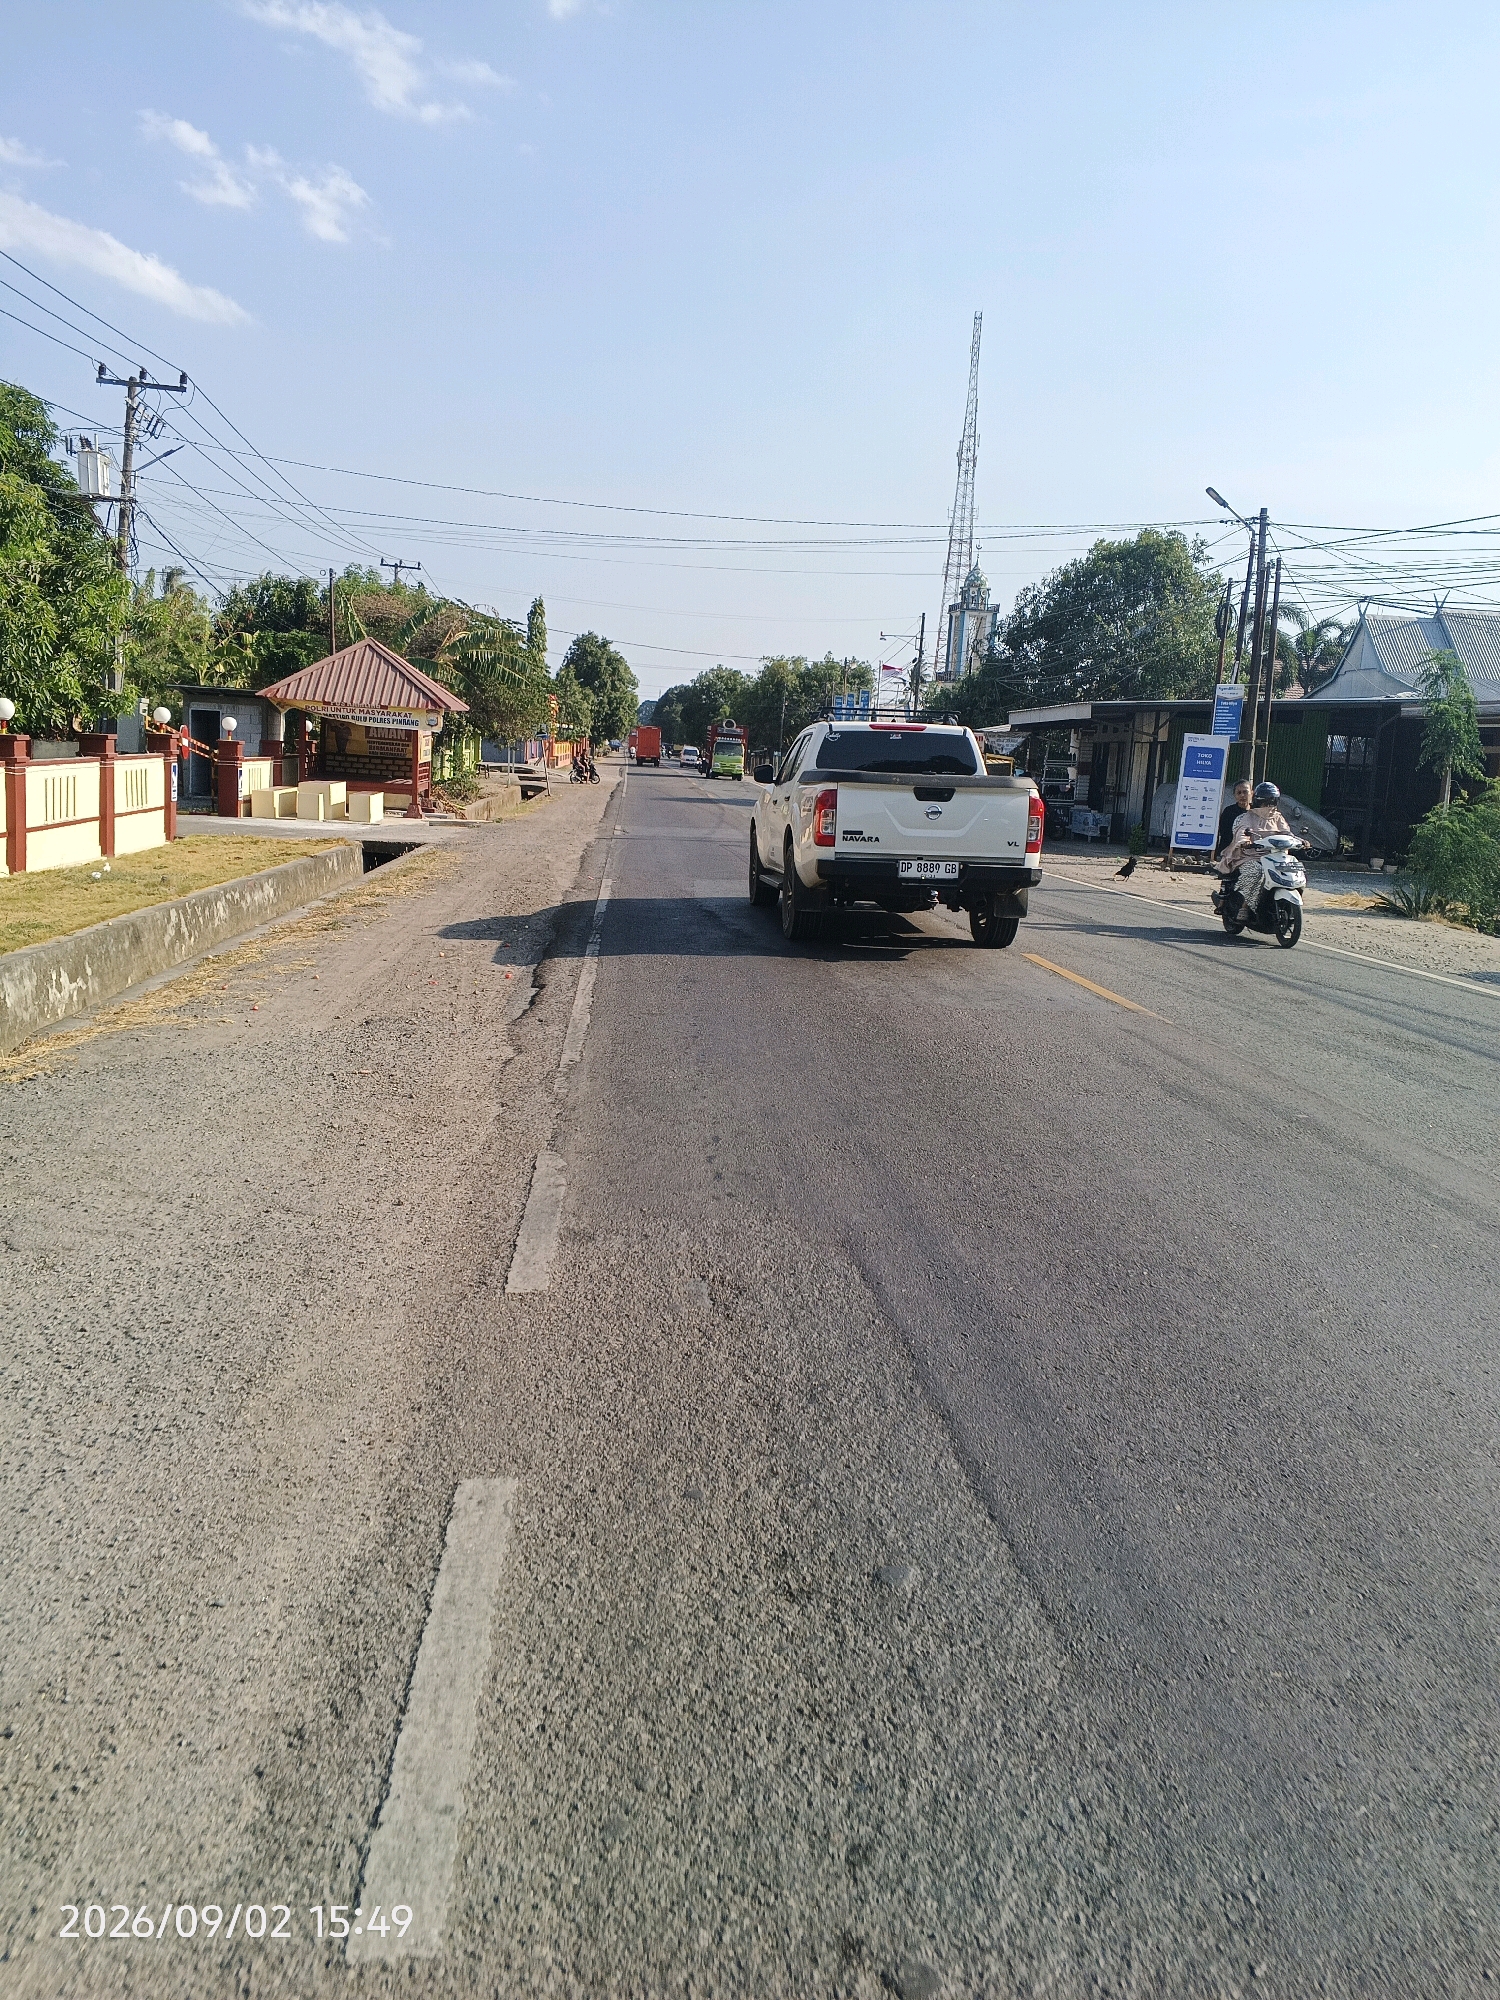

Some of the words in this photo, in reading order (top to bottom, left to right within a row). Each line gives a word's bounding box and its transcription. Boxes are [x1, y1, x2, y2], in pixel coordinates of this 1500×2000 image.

[304, 705, 329, 713] POLRI
[330, 706, 357, 715] UNTUK
[358, 709, 413, 719] MASYARAKAT
[369, 716, 391, 725] POLRES
[391, 718, 420, 727] PINRANG
[842, 835, 880, 843] NAVARA
[900, 862, 913, 873] DP
[916, 862, 941, 874] 8889
[944, 863, 957, 874] GB
